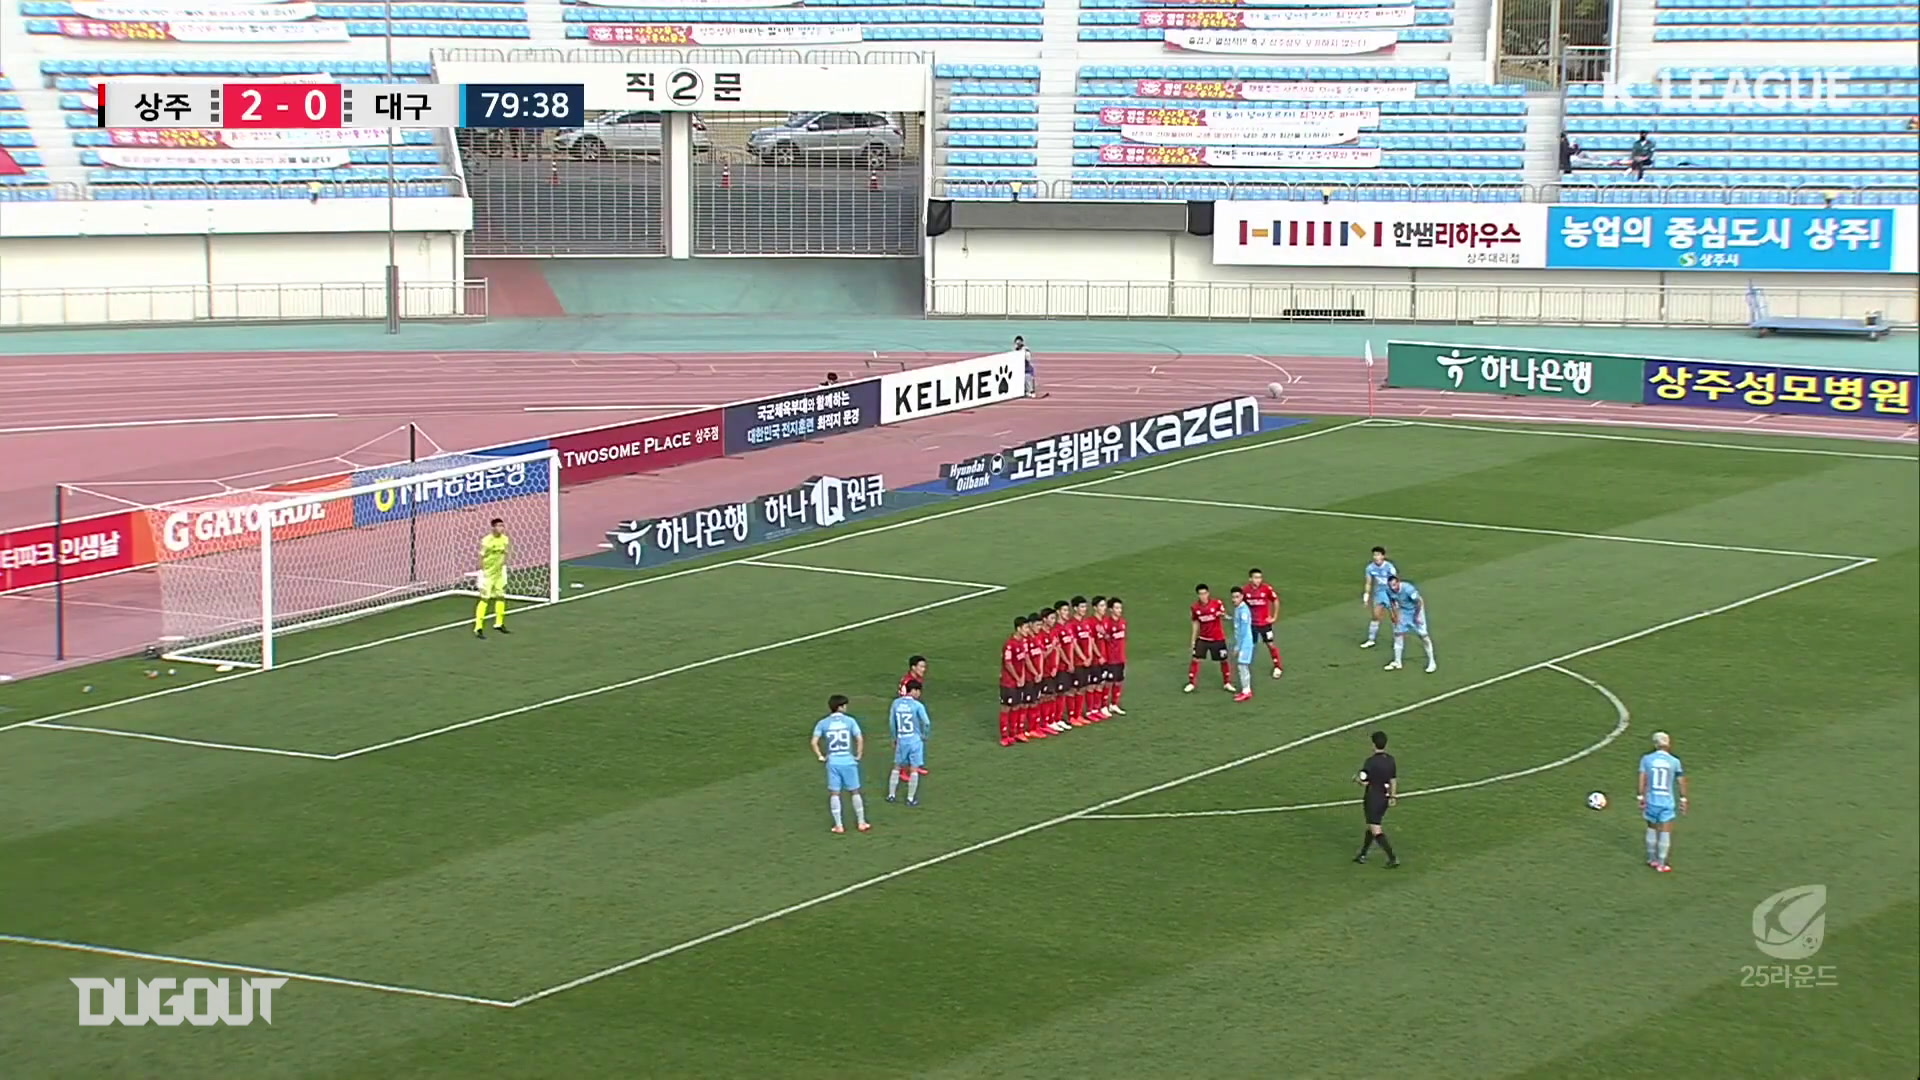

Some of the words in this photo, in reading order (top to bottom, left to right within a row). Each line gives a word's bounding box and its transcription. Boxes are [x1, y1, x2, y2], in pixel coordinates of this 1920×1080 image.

[626, 72, 655, 102] 직
[713, 72, 742, 102] 문
[1560, 216, 1652, 249] 농업의
[1664, 217, 1791, 250] 중심도시
[1804, 218, 1882, 251] 상주!
[1699, 253, 1739, 267] 상주시
[1481, 355, 1592, 394] 하나은행
[1649, 366, 1910, 414] 상주성모병원
[816, 391, 850, 410] 함께하는
[894, 369, 992, 416] KELME
[747, 424, 780, 444] 대한민국
[817, 412, 841, 430] 최적지
[843, 408, 860, 426] 문경
[564, 442, 641, 467] TWOSOME
[644, 432, 691, 454] PLACE
[695, 426, 719, 444] 상주점
[1009, 425, 1124, 481] 고급휘발유
[950, 457, 985, 478] Hyundai
[956, 473, 990, 492] Oilbank
[163, 511, 190, 552] G
[656, 503, 748, 554] 하나은행
[58, 530, 121, 565] 인생날
[895, 712, 914, 733] 13
[826, 730, 851, 751] 29
[1651, 767, 1668, 790] 11
